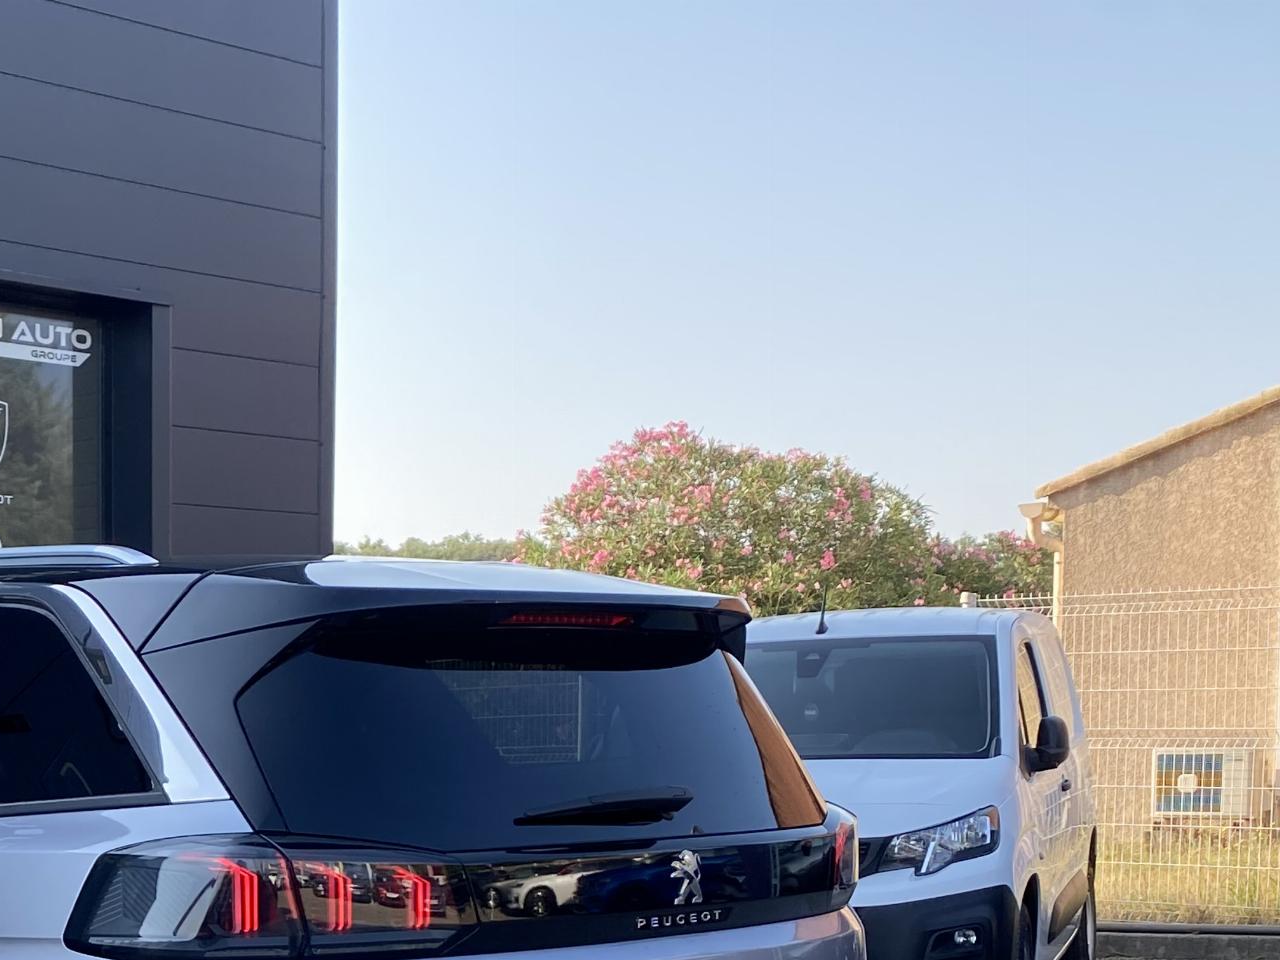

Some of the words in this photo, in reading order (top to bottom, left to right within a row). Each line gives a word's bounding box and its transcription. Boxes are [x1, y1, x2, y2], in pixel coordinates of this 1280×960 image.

[11, 321, 93, 350] AUTO
[30, 349, 78, 364] GROUPE
[637, 909, 723, 930] PEUGEOT
